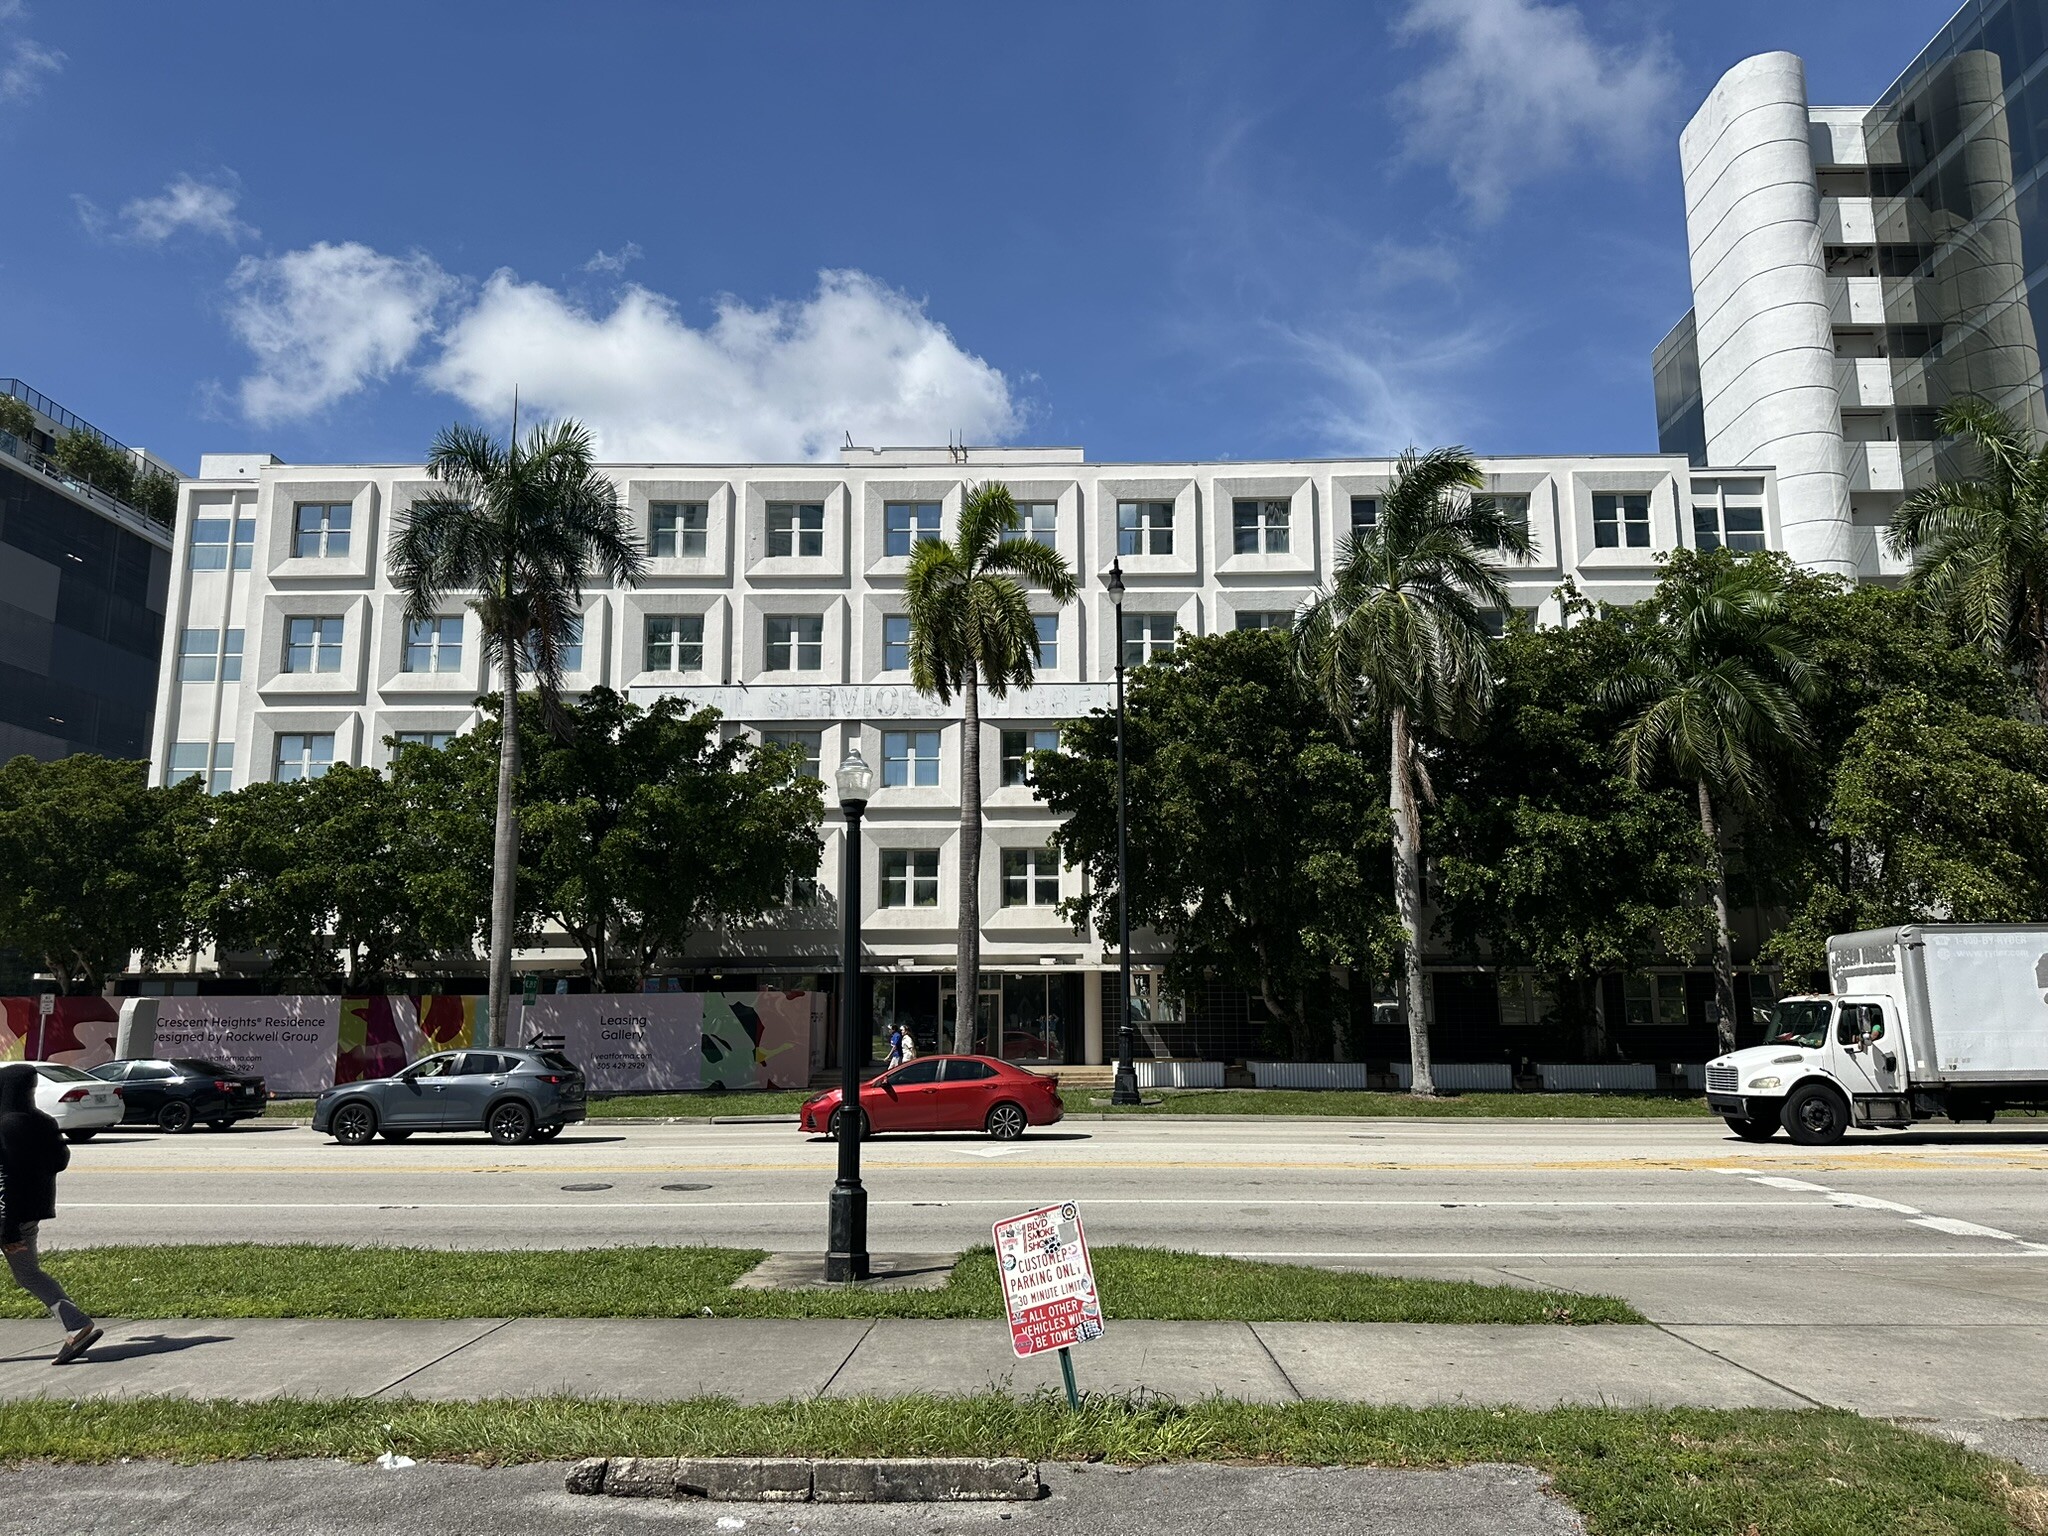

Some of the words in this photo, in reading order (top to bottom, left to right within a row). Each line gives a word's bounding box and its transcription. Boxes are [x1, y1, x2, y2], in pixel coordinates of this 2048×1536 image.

[157, 1017, 208, 1027] Crescent
[265, 1017, 326, 1027] Residence
[600, 1015, 647, 1028] Leasing
[207, 1031, 223, 1043] by
[226, 1031, 279, 1042] Rockwell
[281, 1032, 319, 1044] Group
[601, 1029, 645, 1042] Gallery
[612, 1062, 626, 1070] 429
[627, 1062, 646, 1070] 2929
[1027, 1218, 1048, 1232] BLVD
[1027, 1226, 1056, 1242] SMOKE
[1010, 1268, 1053, 1293] PARKING
[1030, 1286, 1060, 1304] MINUTE
[1061, 1280, 1082, 1295] LIMIT
[1029, 1309, 1047, 1323] ALL
[1048, 1299, 1079, 1317] OTHER
[1021, 1316, 1066, 1337] VEHICLES
[1035, 1334, 1050, 1348] BE
[1050, 1327, 1079, 1345] TOWE
